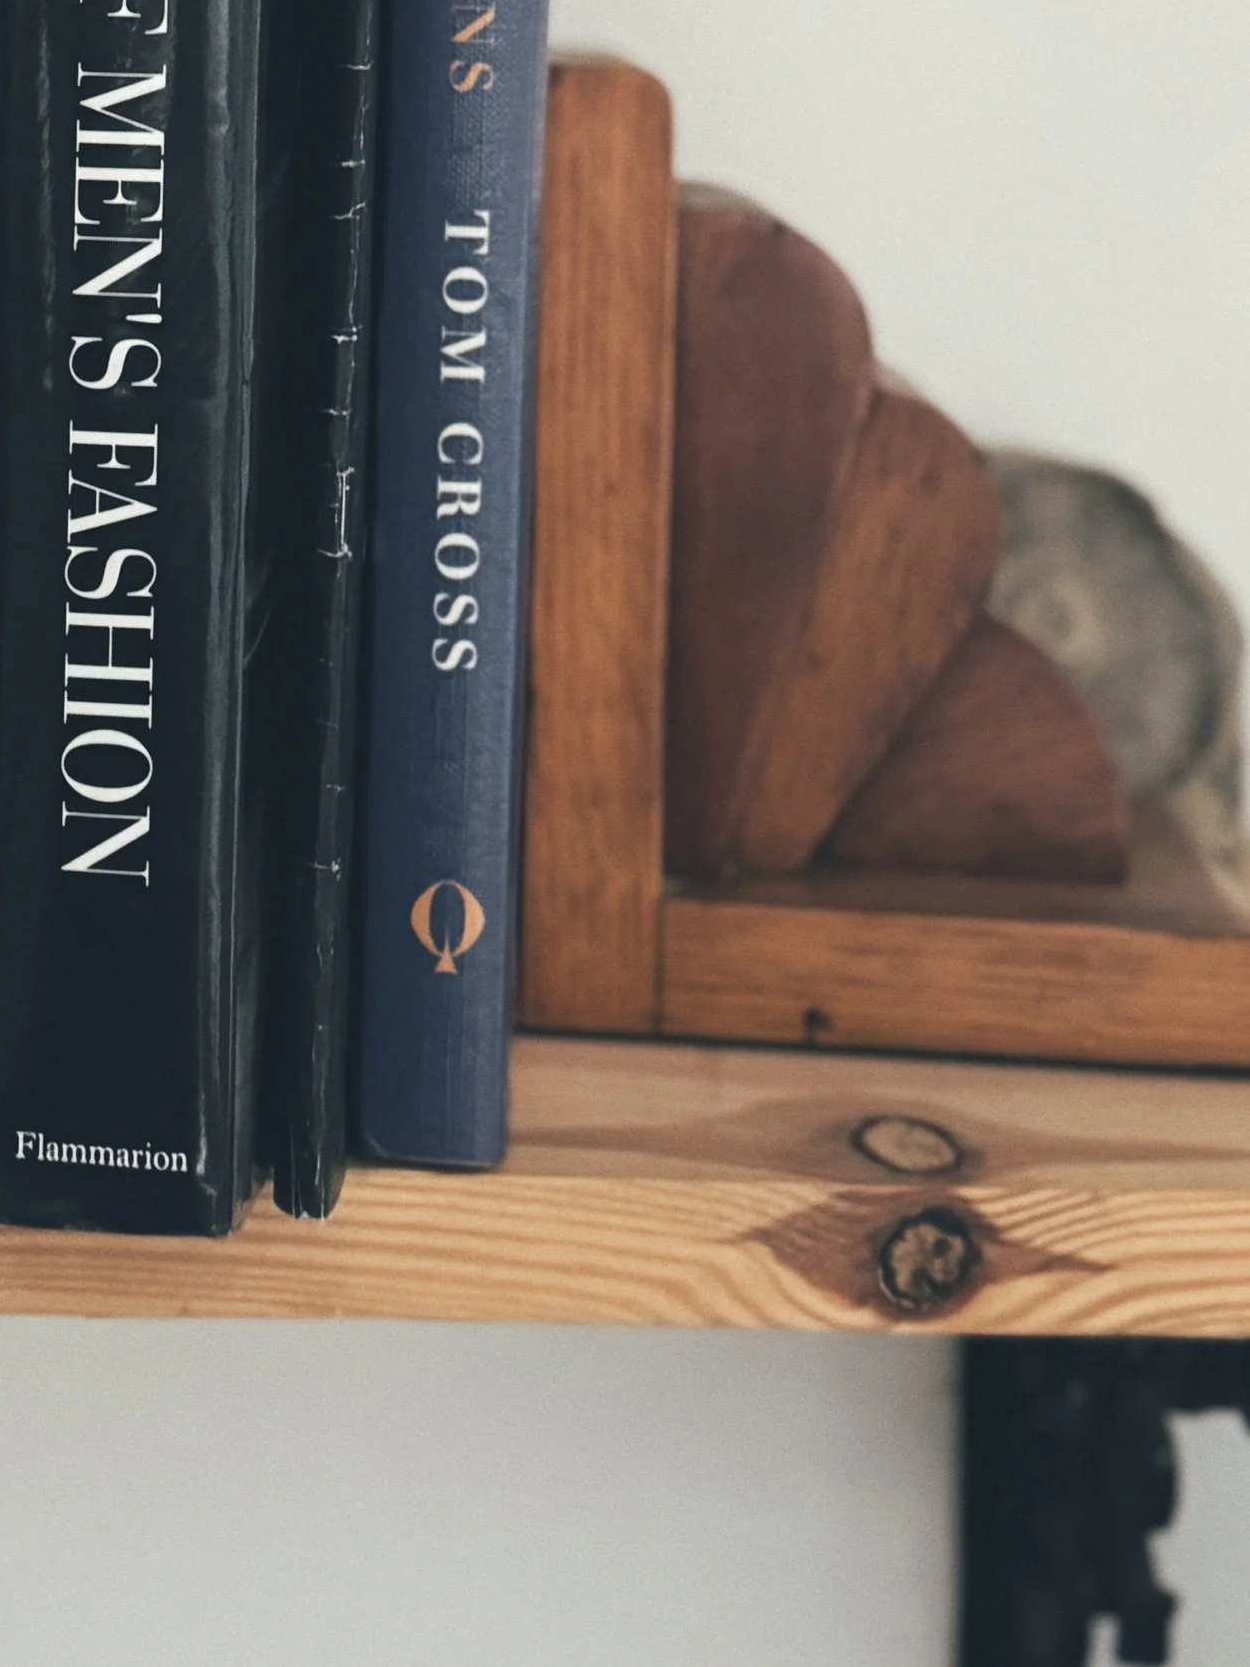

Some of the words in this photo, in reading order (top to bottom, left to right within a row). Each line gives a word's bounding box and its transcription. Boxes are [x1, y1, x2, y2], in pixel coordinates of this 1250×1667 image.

[68, 61, 167, 391] MEN'S
[438, 208, 494, 385] TOM
[60, 419, 159, 888] FASHION
[431, 420, 485, 673] CROSS
[14, 1129, 190, 1174] Flammarion
